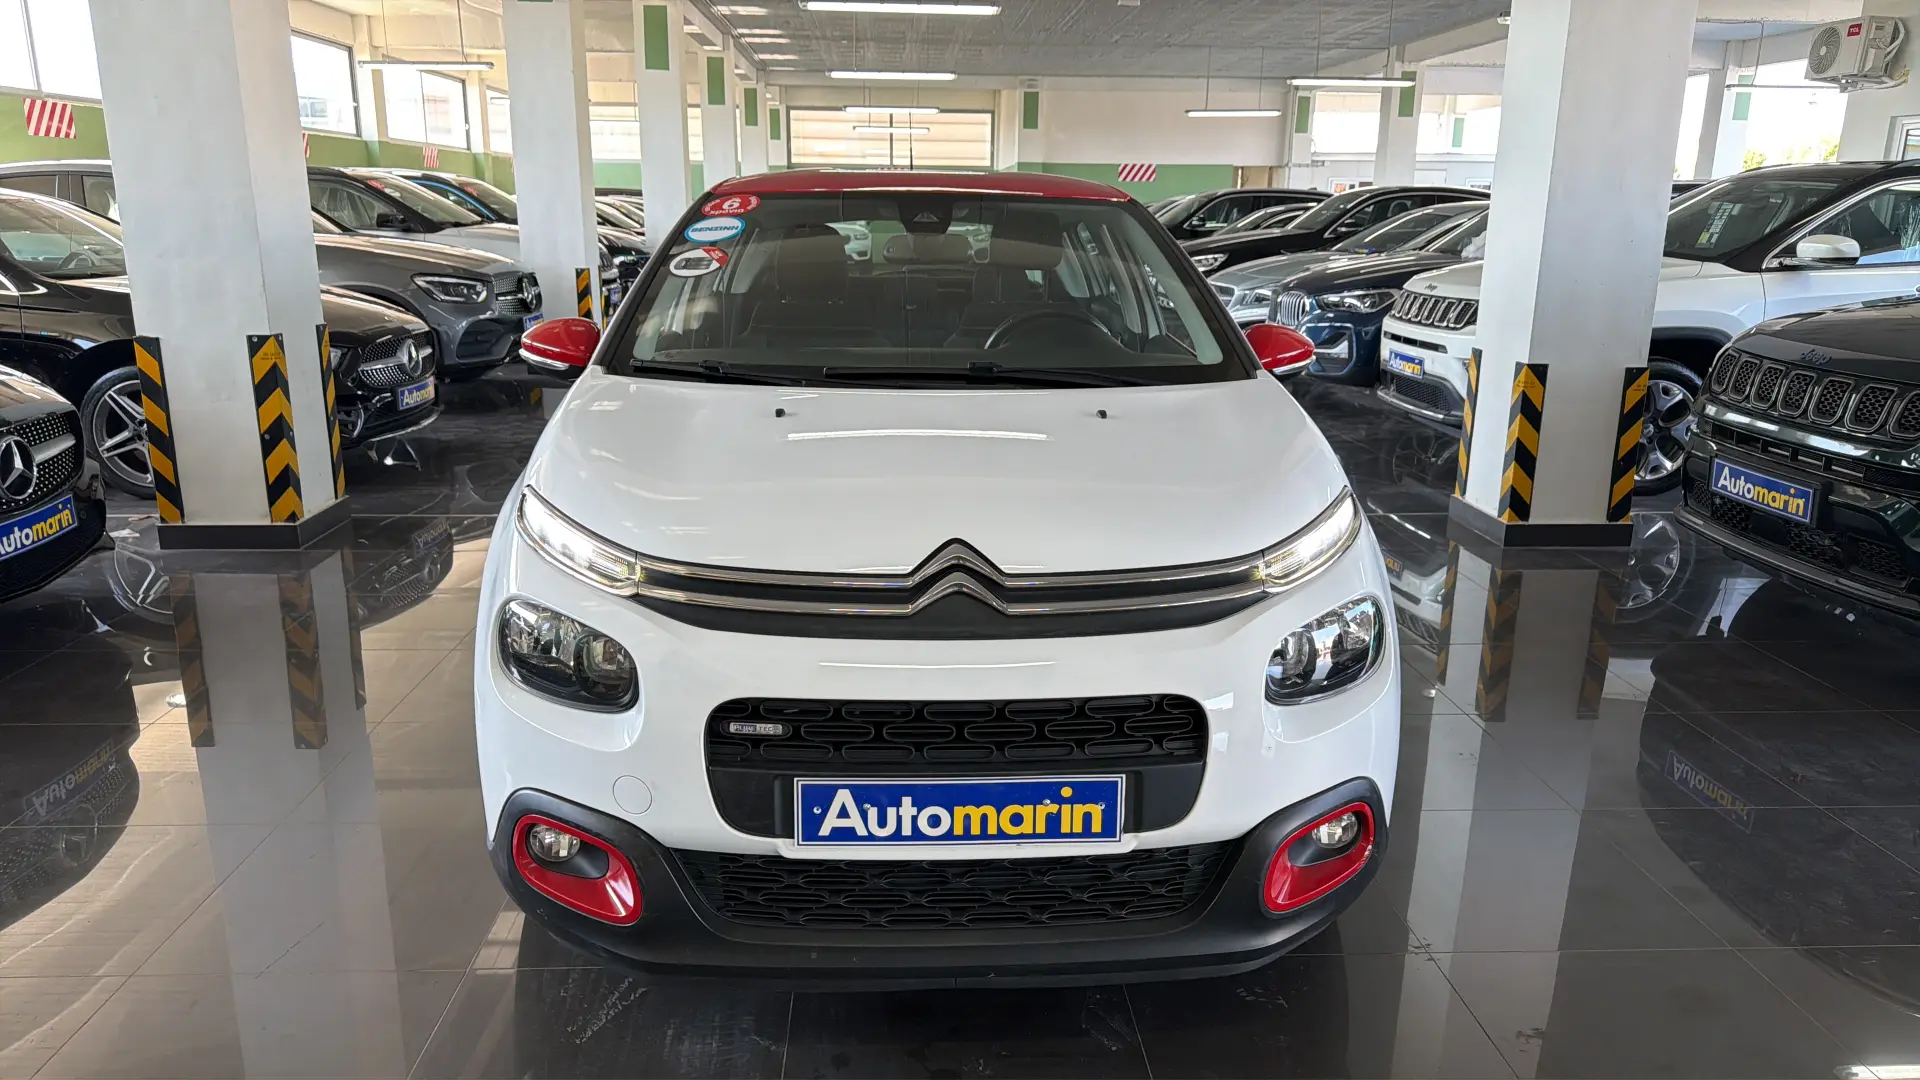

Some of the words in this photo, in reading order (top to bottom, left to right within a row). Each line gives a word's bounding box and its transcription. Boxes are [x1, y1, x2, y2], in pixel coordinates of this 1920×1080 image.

[722, 198, 742, 210] 6
[1800, 349, 1832, 365] Jeep
[1717, 465, 1806, 517] Automarin
[817, 786, 1102, 837] Automarin
